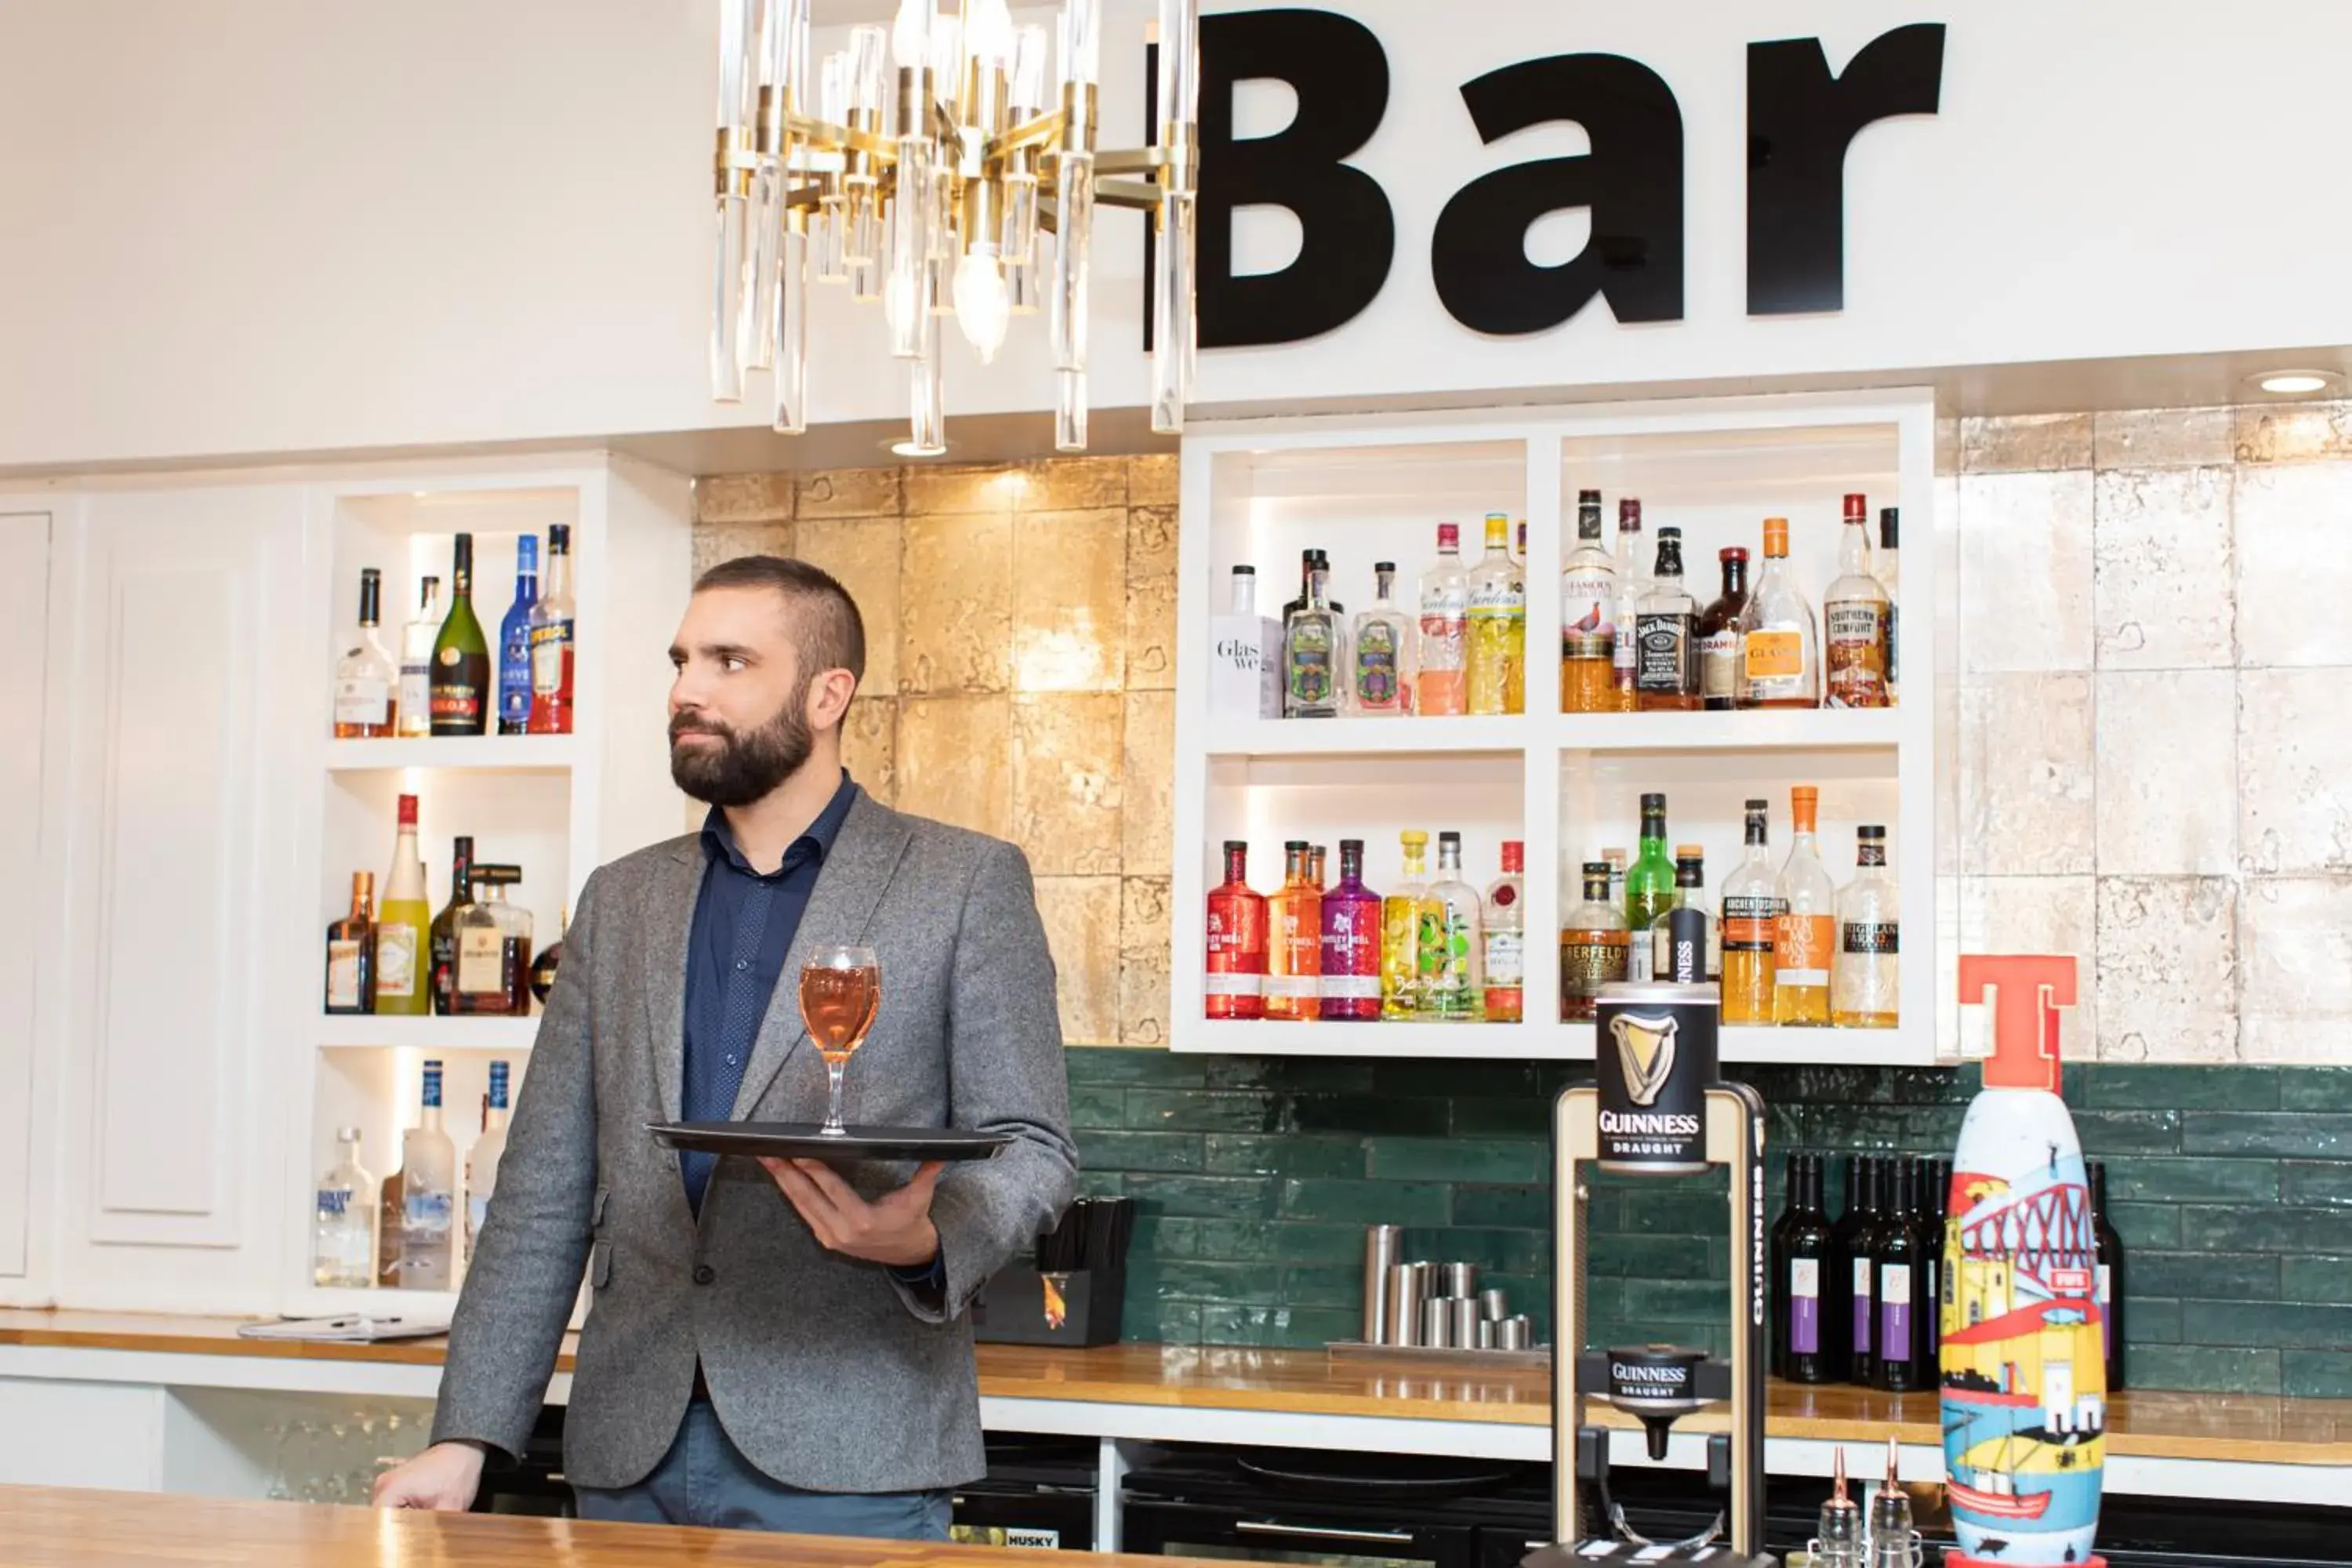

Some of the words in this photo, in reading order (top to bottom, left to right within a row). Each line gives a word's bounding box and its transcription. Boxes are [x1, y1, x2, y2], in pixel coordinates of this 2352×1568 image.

[1145, 7, 1947, 352] Bar
[1217, 639, 1259, 658] Glas
[1599, 1110, 1700, 1135] GUINNESS
[1613, 1142, 1684, 1155] DRAUGHT
[1612, 1362, 1687, 1382] GUINNESS
[1621, 1385, 1675, 1396] DRAUGHT
[1008, 1536, 1054, 1547] HUSKY
